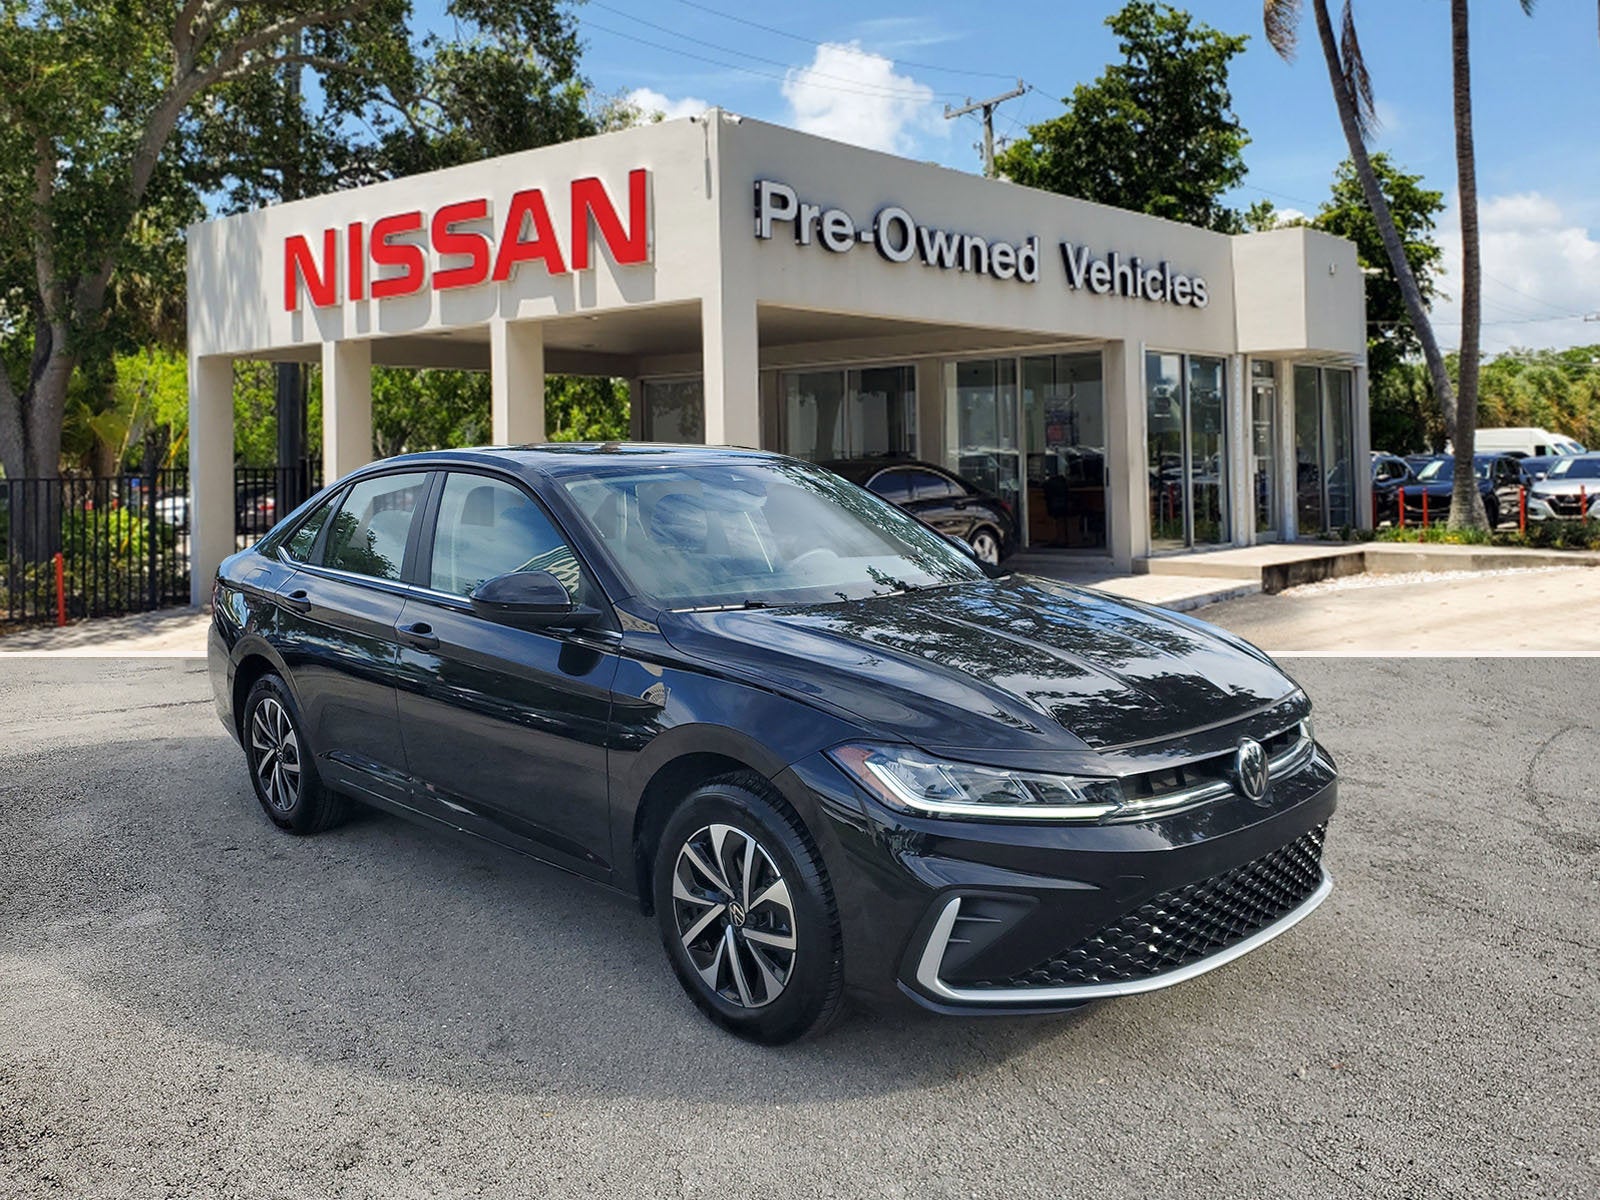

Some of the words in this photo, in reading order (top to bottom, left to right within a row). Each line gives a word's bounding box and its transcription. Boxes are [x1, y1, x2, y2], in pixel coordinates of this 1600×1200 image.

[284, 169, 648, 312] NISSAN
[754, 179, 1039, 284] Pre-Owned
[1060, 241, 1208, 308] Vehicles
